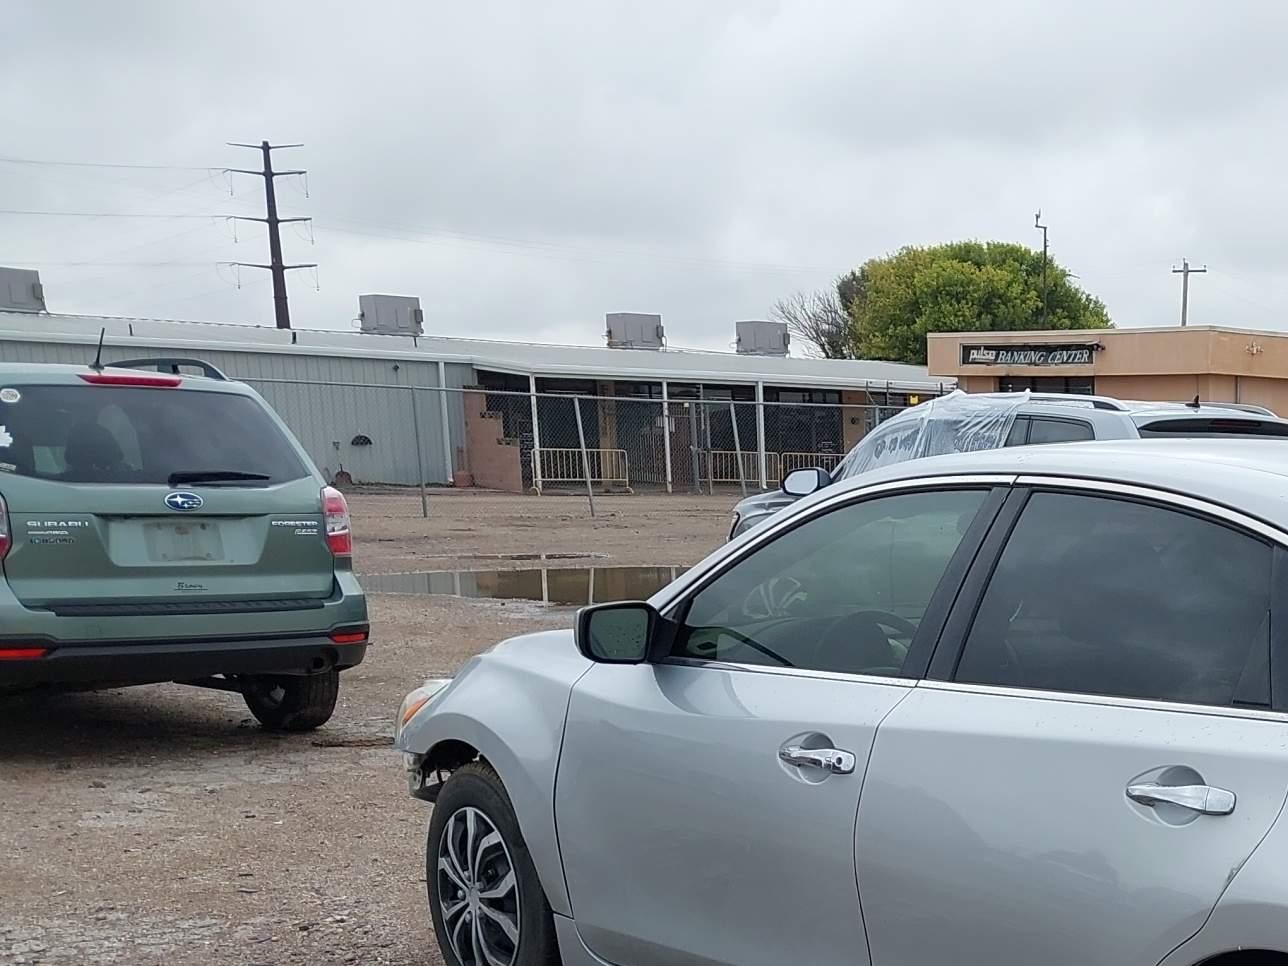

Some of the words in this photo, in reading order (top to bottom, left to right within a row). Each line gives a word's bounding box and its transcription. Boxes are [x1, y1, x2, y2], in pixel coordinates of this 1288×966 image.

[969, 346, 996, 362] pulse
[997, 350, 1045, 363] BANKING
[1047, 349, 1090, 363] CENTER
